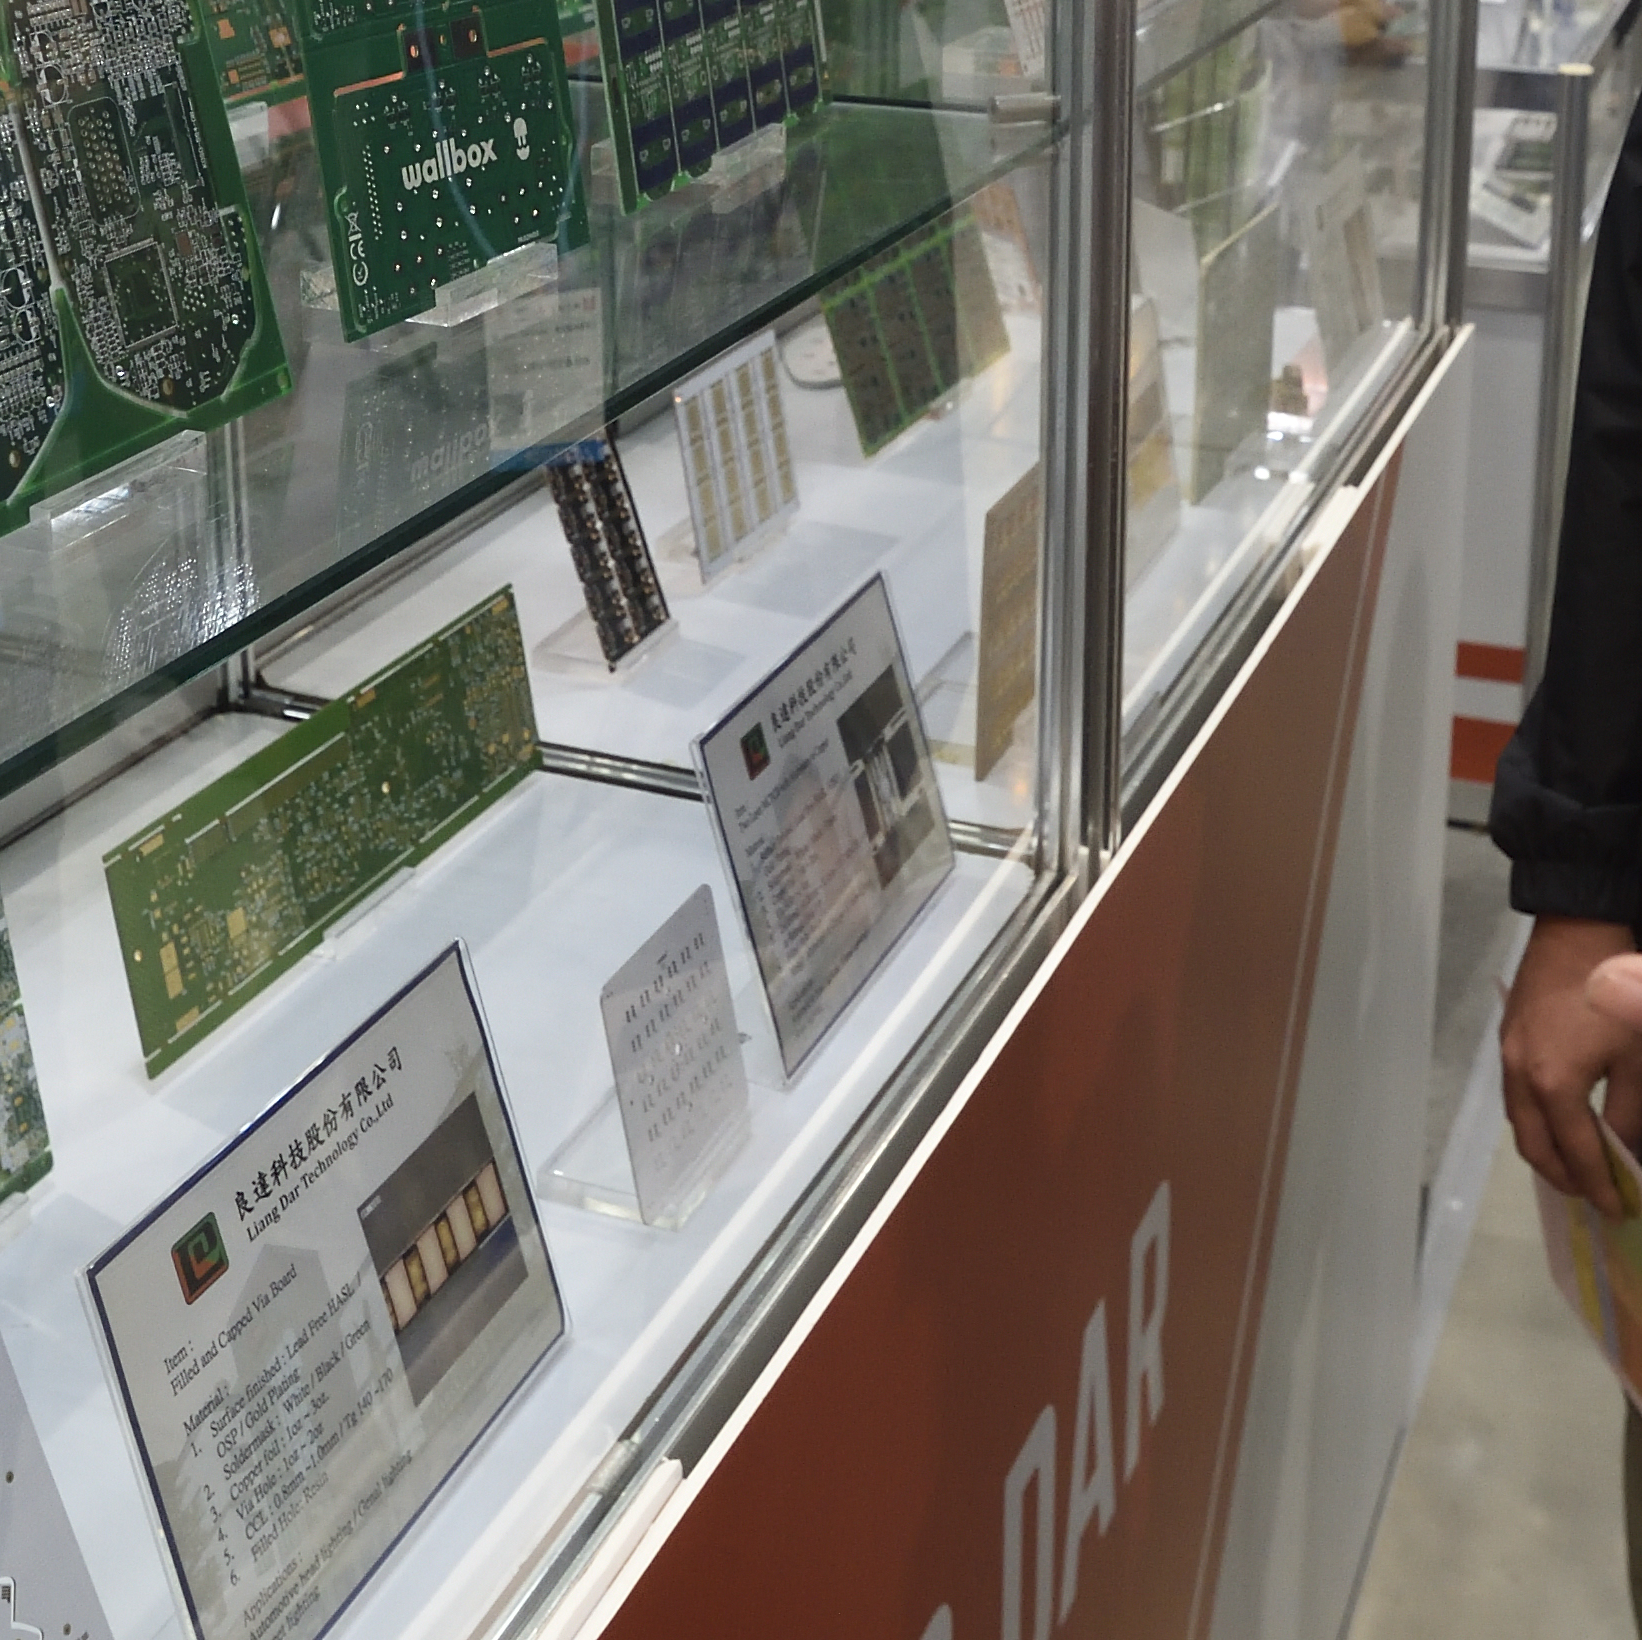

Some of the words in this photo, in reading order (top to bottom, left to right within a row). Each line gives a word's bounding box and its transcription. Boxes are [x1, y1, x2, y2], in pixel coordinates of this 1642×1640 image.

[401, 137, 498, 191] wallbox
[233, 1043, 403, 1223] 良達科技股份有限公司
[246, 1201, 280, 1244] Liang
[278, 1179, 301, 1213] Dar
[299, 1124, 360, 1191] Technology
[170, 1357, 200, 1397] Filled
[199, 1339, 217, 1368] and
[216, 1305, 254, 1352] Capped
[252, 1287, 270, 1316] Via
[269, 1262, 297, 1299] Board
[209, 1391, 246, 1439] Surface
[245, 1355, 281, 1403] finished
[286, 1326, 309, 1360] Lead
[308, 1306, 328, 1337] Free
[327, 1279, 354, 1318] HASL
[183, 1386, 224, 1437] Material
[216, 1425, 240, 1460] OSP
[243, 1394, 268, 1431] Gold
[268, 1365, 300, 1406] Plating
[222, 1416, 276, 1481] Soldermask
[282, 1377, 311, 1417] White
[315, 1347, 340, 1383] Black
[344, 1316, 371, 1352] Green
[1001, 1180, 1173, 1640] DAR
[228, 1457, 264, 1503] Copper
[262, 1437, 280, 1466] foil
[285, 1416, 302, 1442] 1oz
[236, 1493, 254, 1522] Via
[252, 1470, 277, 1505] Hole
[283, 1446, 299, 1471] 1oz
[244, 1506, 268, 1542] CCL
[272, 1467, 305, 1511] 0.8mm
[342, 1407, 358, 1432] Tg
[356, 1389, 373, 1417] 140
[250, 1522, 279, 1563] Filled
[302, 1468, 329, 1503] Resin
[299, 1554, 320, 1585] head
[320, 1518, 353, 1562] lighting
[241, 1557, 298, 1628] Applications
[285, 1584, 320, 1628] lighting
